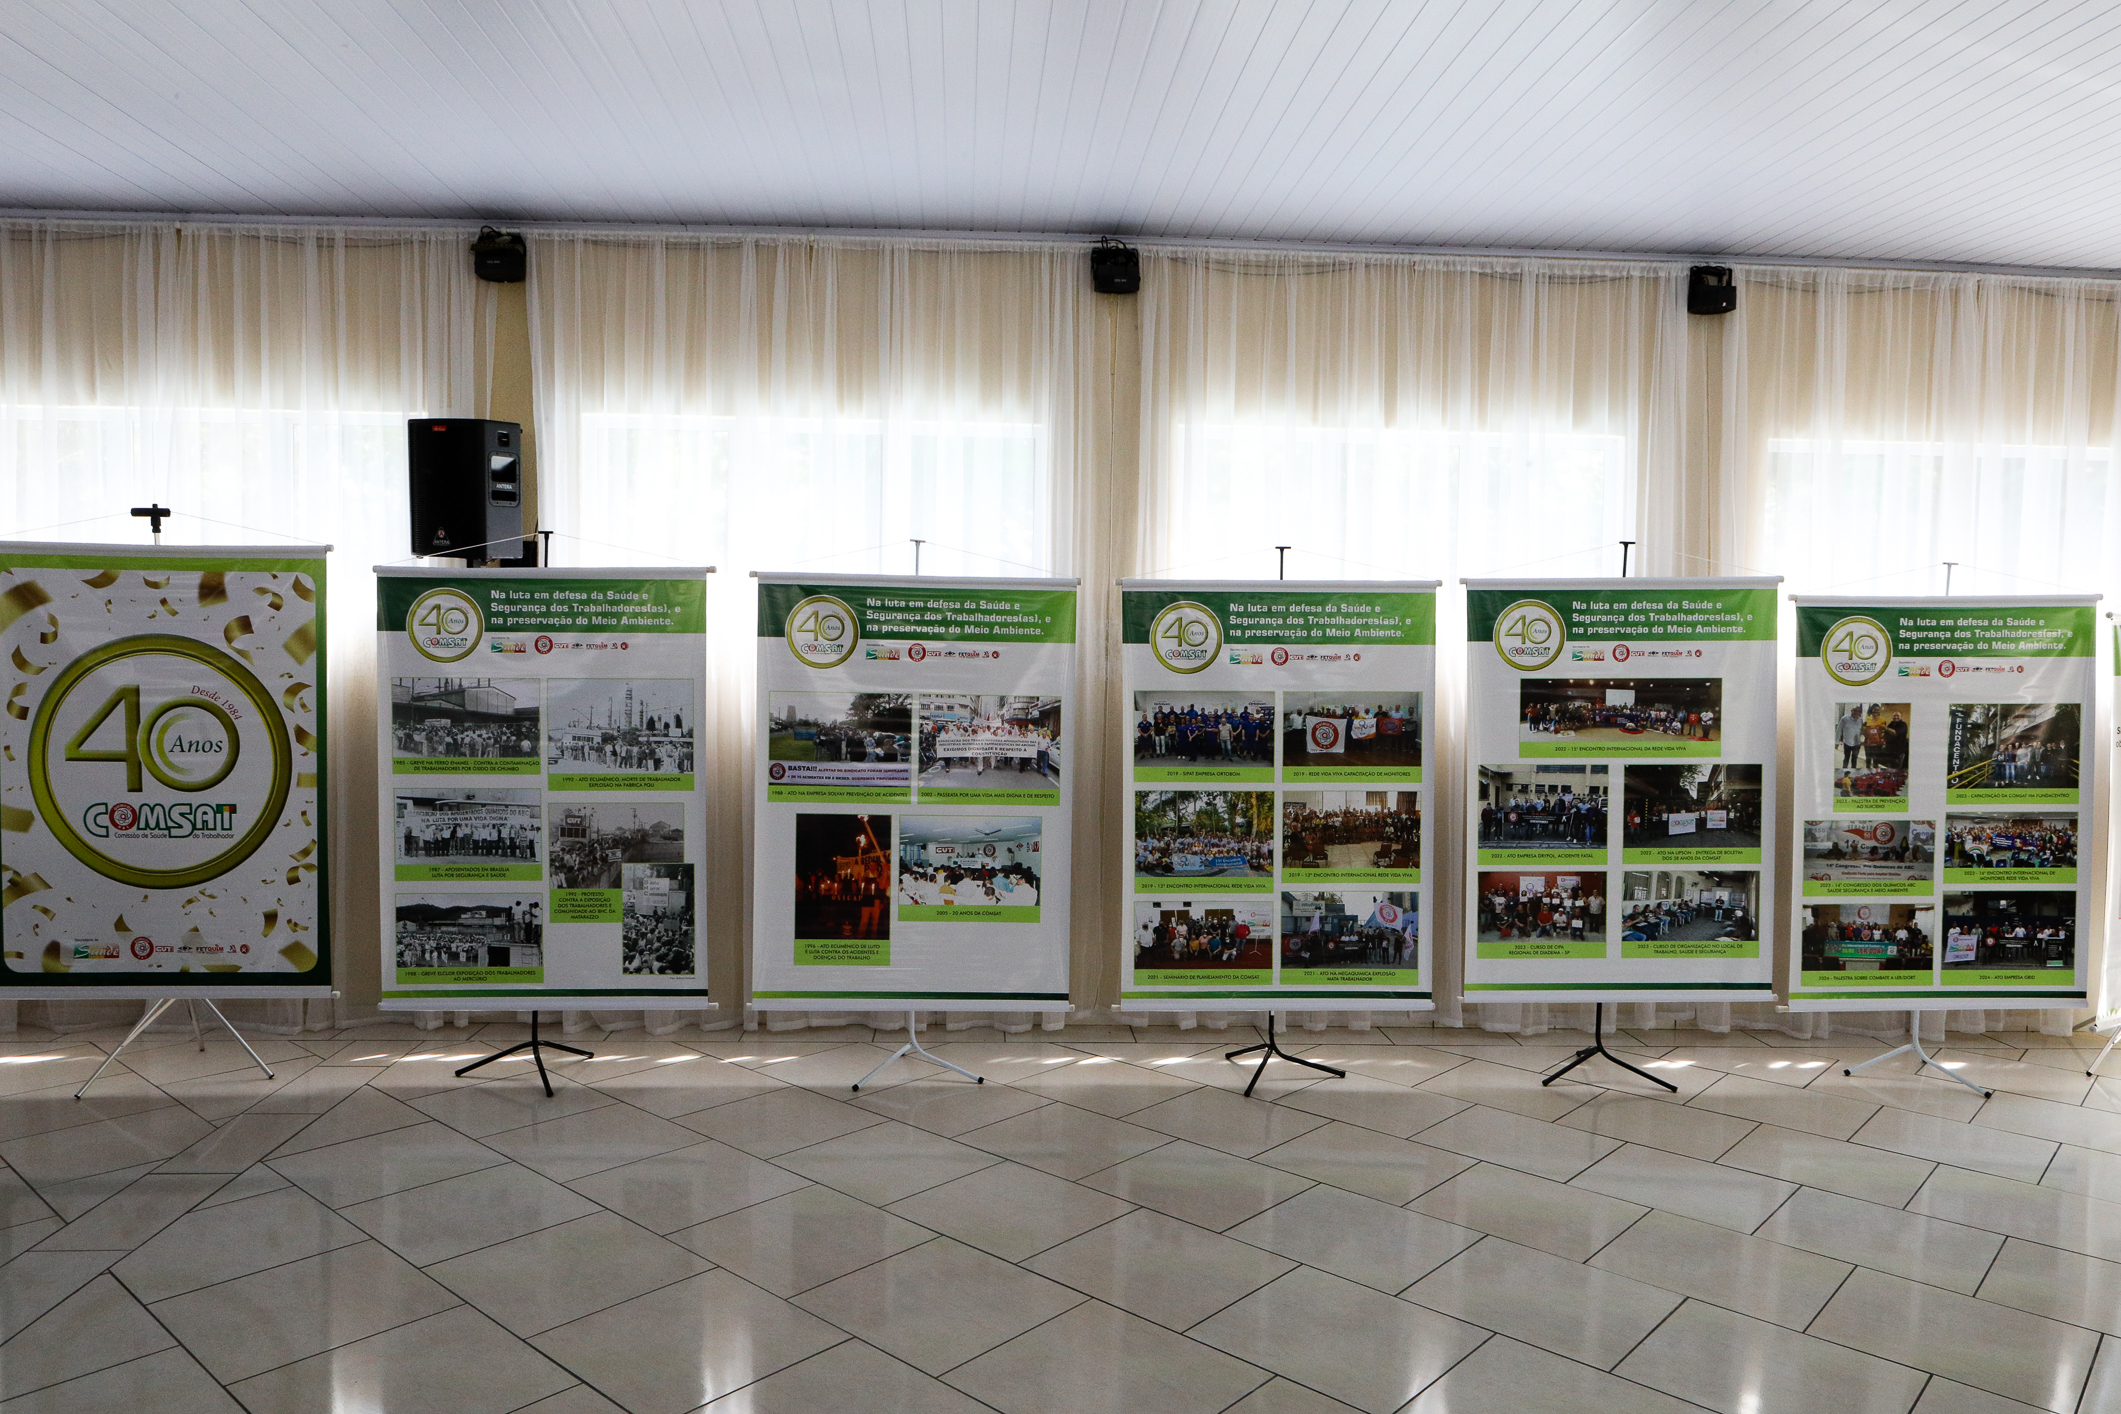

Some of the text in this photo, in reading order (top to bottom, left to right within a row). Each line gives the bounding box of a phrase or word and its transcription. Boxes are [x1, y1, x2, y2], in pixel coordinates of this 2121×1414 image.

[490, 590, 506, 598] Na
[509, 590, 530, 599] luta
[552, 590, 587, 599] defesa
[590, 591, 603, 599] da
[606, 590, 639, 600] Saúde
[490, 602, 546, 614] Segurança
[550, 603, 569, 612] dos
[572, 603, 671, 613] Trabalhadores(as),
[866, 597, 881, 606] Na
[884, 598, 906, 607] luta
[926, 599, 960, 608] defesa
[964, 600, 976, 608] da
[979, 600, 1011, 609] Saúde
[1229, 603, 1244, 611] Na
[1247, 603, 1268, 612] luta
[1289, 603, 1322, 612] defesa
[1325, 603, 1337, 612] da
[1340, 603, 1371, 612] Saúde
[1572, 601, 1586, 609] Na
[1590, 601, 1610, 609] luta
[1630, 600, 1663, 609] defesa
[1666, 600, 1678, 609] da
[1682, 600, 1713, 609] Saúde
[418, 603, 469, 635] 40
[507, 615, 572, 626] preservação
[575, 616, 588, 624] do
[591, 616, 617, 624] Meio
[620, 616, 674, 625] Ambiente.
[866, 610, 921, 622] Segurança
[924, 611, 942, 620] dos
[945, 612, 1041, 623] Trabalhadores(as),
[1229, 615, 1283, 626] Segurança
[1286, 616, 1304, 624] dos
[1307, 615, 1402, 625] Trabalhadores(as),
[1572, 613, 1624, 623] Segurança
[1628, 613, 1645, 621] dos
[1648, 612, 1743, 622] Trabalhadores(as),
[1899, 617, 1914, 626] Na
[1916, 617, 1936, 626] luta
[1957, 617, 1988, 626] defesa
[1991, 618, 2003, 626] da
[2006, 617, 2036, 626] Saúde
[796, 610, 845, 641] 40
[881, 623, 945, 635] preservação
[948, 625, 961, 633] do
[964, 625, 989, 634] Meio
[992, 625, 1044, 635] Ambiente.
[1504, 615, 1552, 644] 40
[1587, 625, 1648, 635] preservação
[1651, 625, 1664, 633] do
[1667, 624, 1692, 633] Meio
[1695, 624, 1746, 633] Ambiente.
[1161, 616, 1209, 647] 40
[1245, 628, 1307, 638] preservação
[1310, 628, 1322, 636] do
[1326, 628, 1350, 636] Meio
[1354, 628, 1404, 637] Ambiente.
[1899, 629, 1951, 640] Segurança
[1954, 629, 1971, 637] dos
[1974, 629, 2064, 638] Trabalhadores(as),
[423, 638, 468, 648] COMSAT
[801, 643, 844, 654] COMSAT
[1832, 631, 1879, 660] 40
[1913, 641, 1974, 651] preservação
[1976, 641, 1988, 649] do
[1991, 641, 2015, 649] Meio
[2018, 640, 2066, 649] Ambiente.
[1165, 649, 1207, 660] COMSAT
[1509, 646, 1550, 657] COMSAT
[1835, 662, 1877, 672] COMSAT
[190, 684, 244, 722] Desde 1984
[65, 684, 241, 793] 40
[169, 735, 223, 753] Anos
[84, 802, 237, 838] COMSAT
